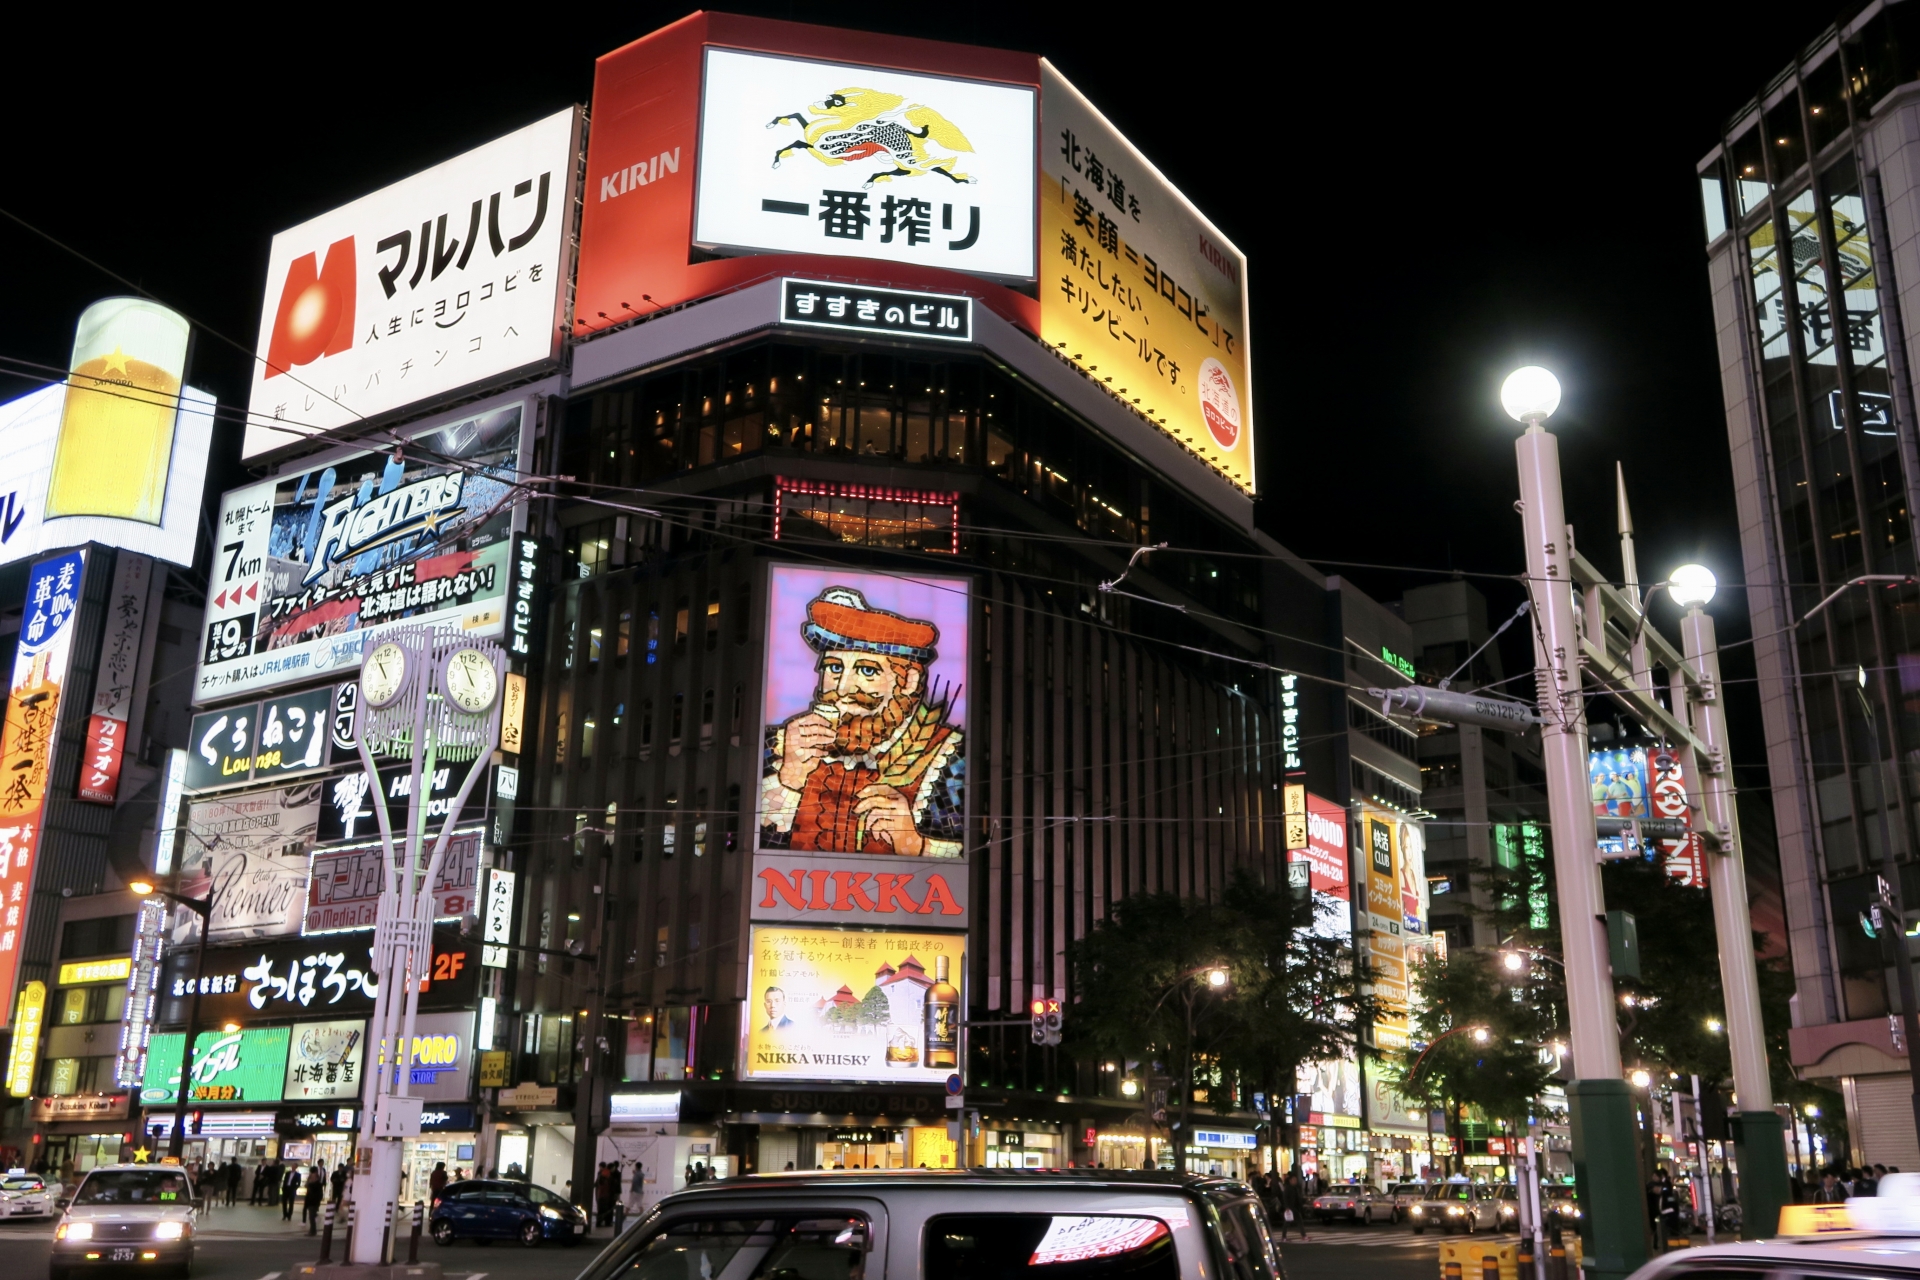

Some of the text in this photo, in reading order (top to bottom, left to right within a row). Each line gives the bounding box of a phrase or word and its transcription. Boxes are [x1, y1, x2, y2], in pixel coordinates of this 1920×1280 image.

[600, 147, 681, 203] KIRIN
[1060, 128, 1141, 224] 北海道を
[376, 171, 551, 300] マルハン
[761, 189, 980, 251] 一番搾り
[1060, 229, 1149, 325] 満たしたい、
[1199, 234, 1236, 286] KIRIN
[365, 263, 543, 344] 人生にヨロコビを
[794, 292, 959, 330] すすきのビル
[1060, 274, 1186, 395] キリンビールです。
[93, 378, 134, 388] SAPPORO
[273, 326, 519, 423] 新しいパチンコへ
[225, 500, 271, 526] 札幌ドーム
[238, 520, 255, 535] まで
[302, 471, 464, 586] FIGHTERS
[27, 575, 54, 643] 革命
[512, 540, 537, 654] すすきのビル
[200, 704, 306, 766] くろねこ
[1281, 674, 1300, 769] すすきのビル
[91, 720, 118, 787] カラオケ
[222, 750, 281, 776] Lounge
[1373, 828, 1389, 852] 快活
[1374, 851, 1390, 868] CLUB
[757, 867, 964, 916] NIKKA
[322, 908, 355, 929] Media
[76, 961, 127, 979] すすきの交番
[434, 953, 466, 981] 2F
[885, 938, 944, 952] 竹鶴政孝の
[14, 1006, 40, 1094] すすきの交番
[293, 1060, 355, 1084] 北海番屋
[756, 1052, 871, 1066] NIKKA WHISKY
[410, 1071, 437, 1085] STORE
